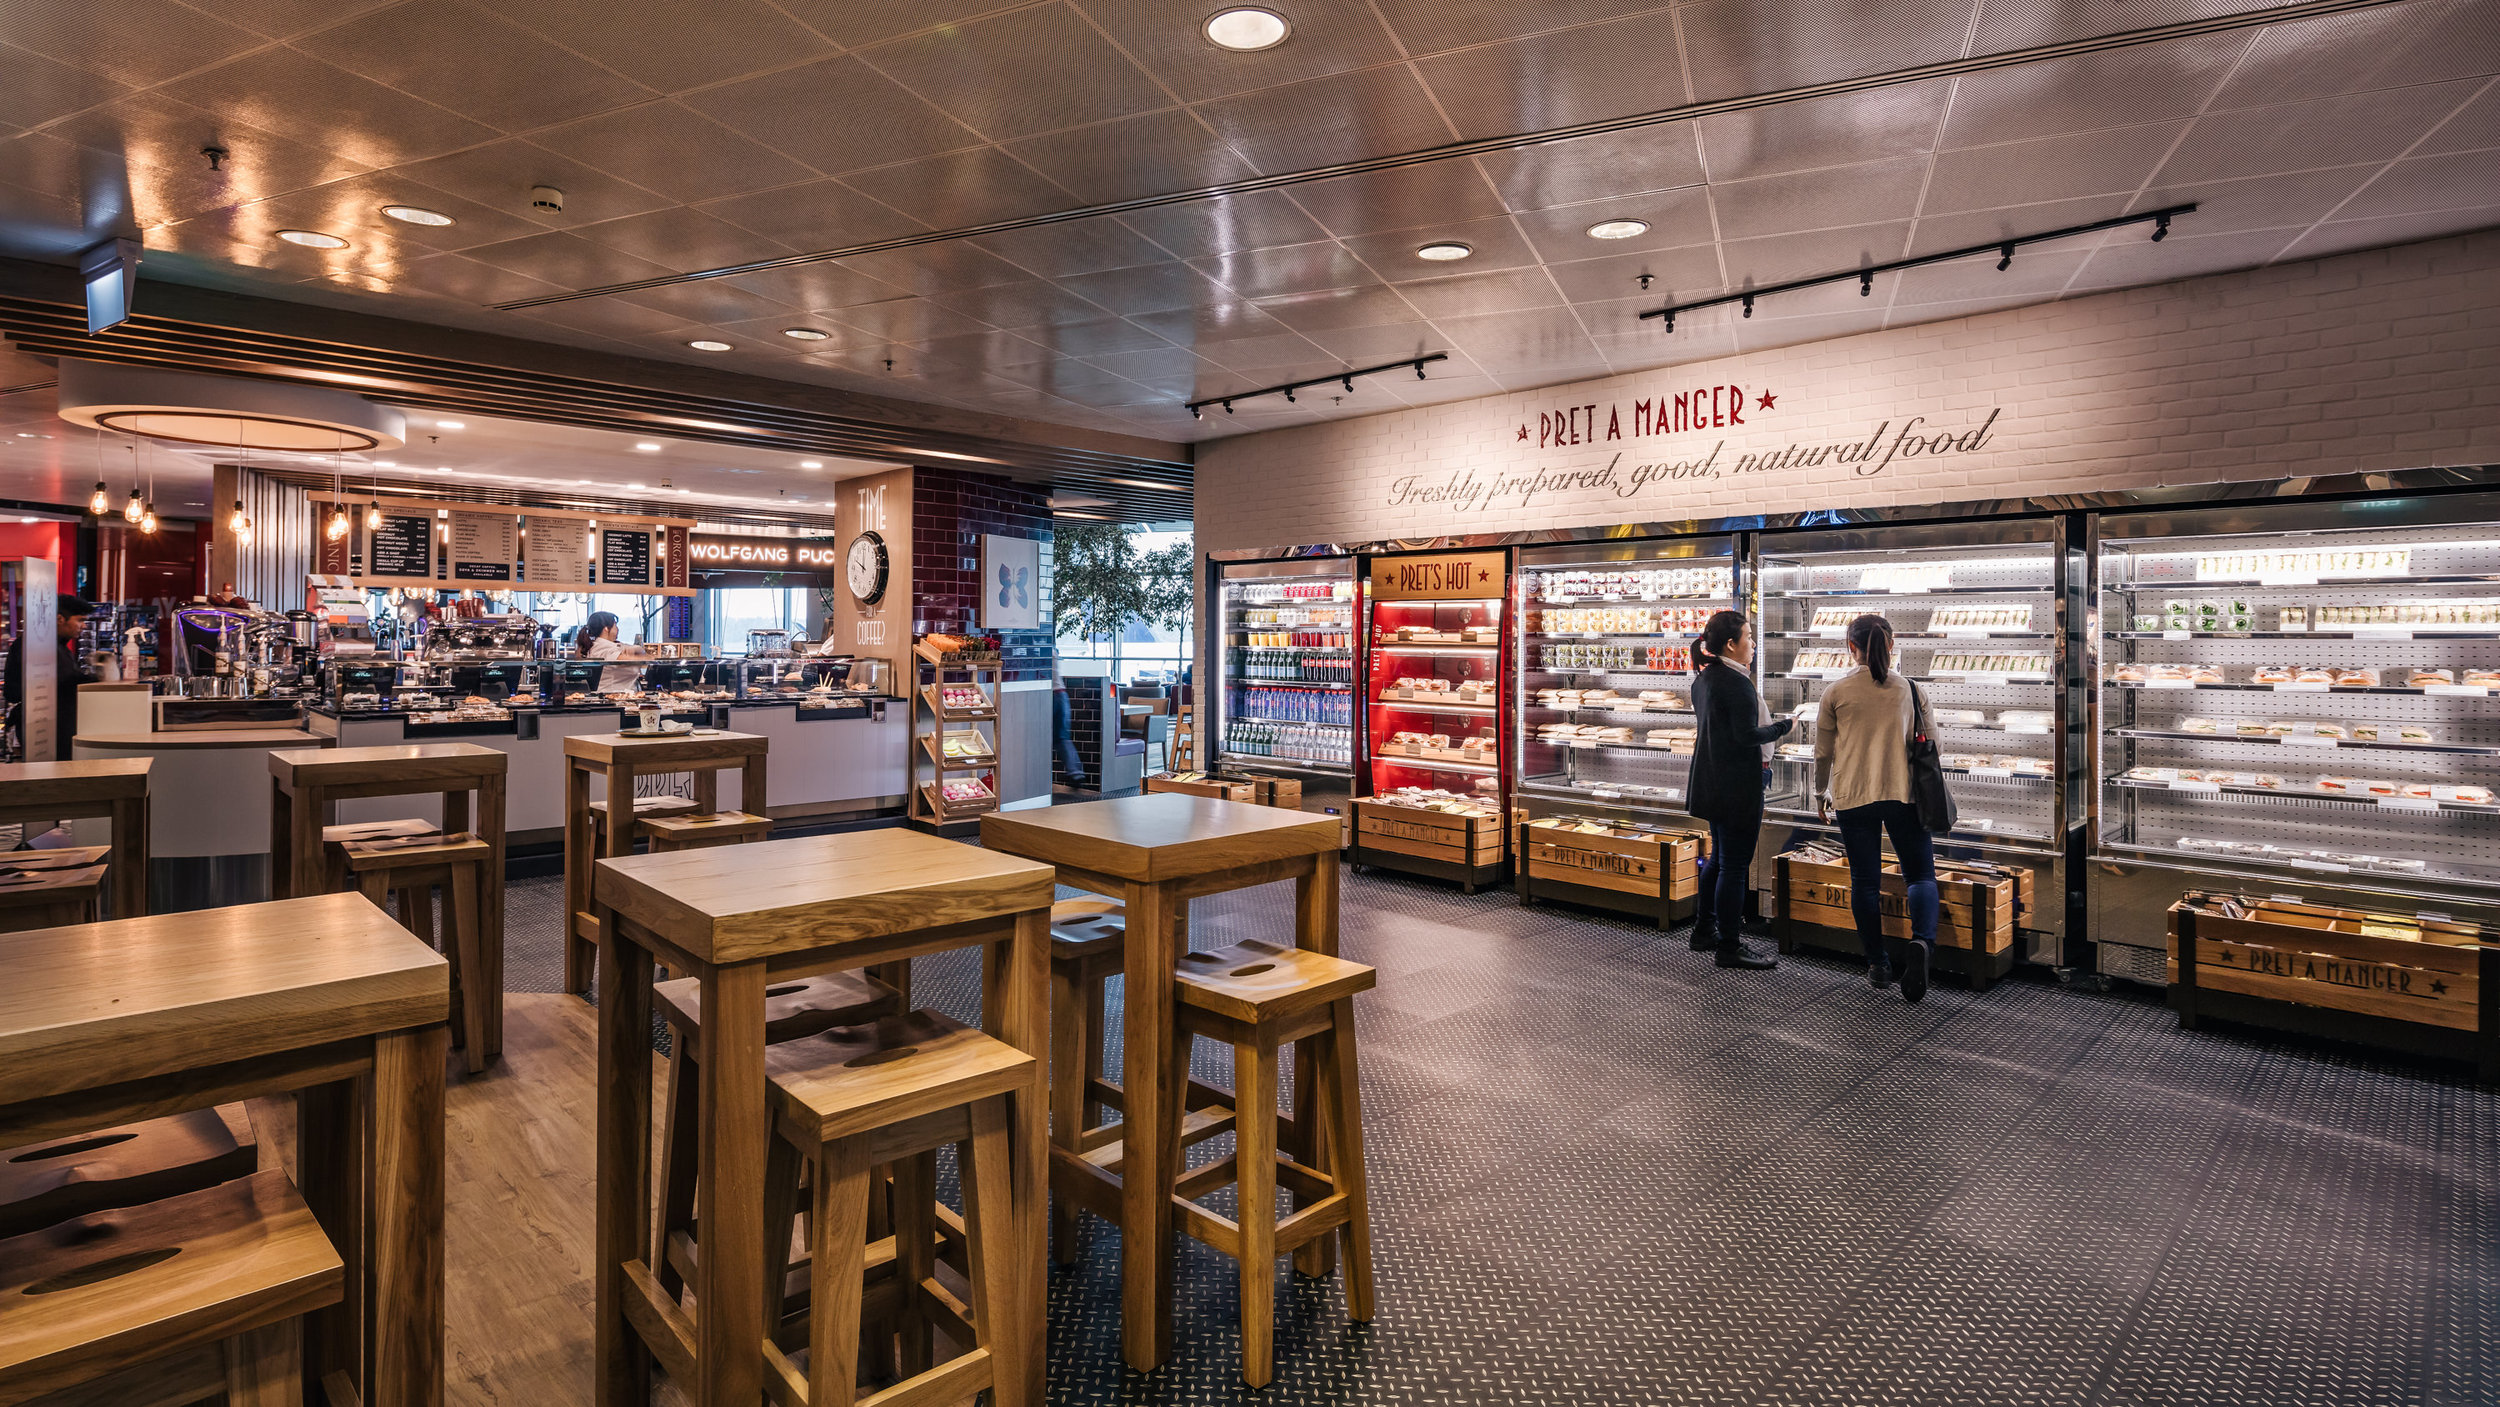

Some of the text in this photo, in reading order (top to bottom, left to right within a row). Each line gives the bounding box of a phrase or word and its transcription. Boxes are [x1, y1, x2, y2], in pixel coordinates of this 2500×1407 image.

[1540, 385, 1745, 448] PRET A MANGER
[1388, 408, 2001, 511] Freshly prepared, good, natural food
[858, 485, 887, 532] TIME
[672, 534, 682, 584] ORGANIC
[690, 544, 788, 562] WOLFGANG
[799, 550, 835, 563] PUC
[1400, 562, 1472, 592] PRET'S HOT
[857, 620, 886, 646] COFFEE?
[1382, 821, 1439, 840] PRET A MANGER
[1554, 848, 1630, 874] PRET A MANGER
[1826, 888, 1849, 906] PRE
[2250, 949, 2412, 993] PRET A MANGER
